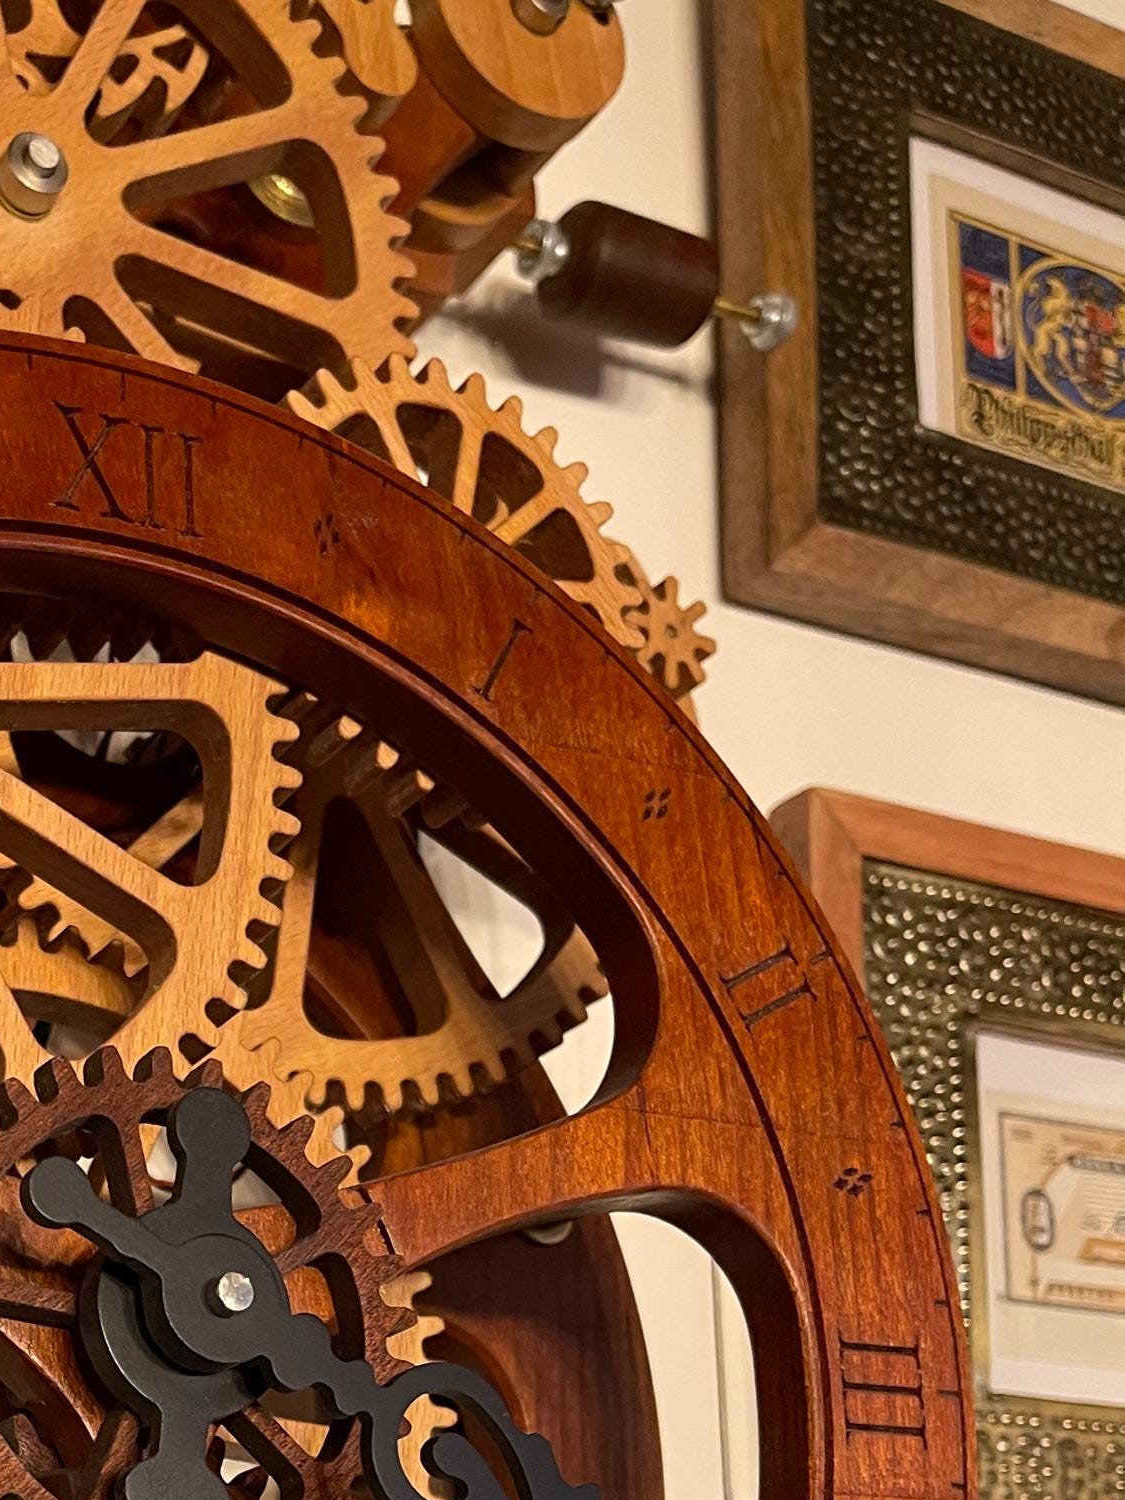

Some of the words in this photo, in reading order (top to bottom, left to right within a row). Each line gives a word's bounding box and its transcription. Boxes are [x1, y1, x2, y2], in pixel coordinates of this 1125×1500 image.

[49, 401, 204, 538] XII
[471, 617, 535, 704] I
[718, 936, 818, 1035] II
[837, 1328, 928, 1450] III
